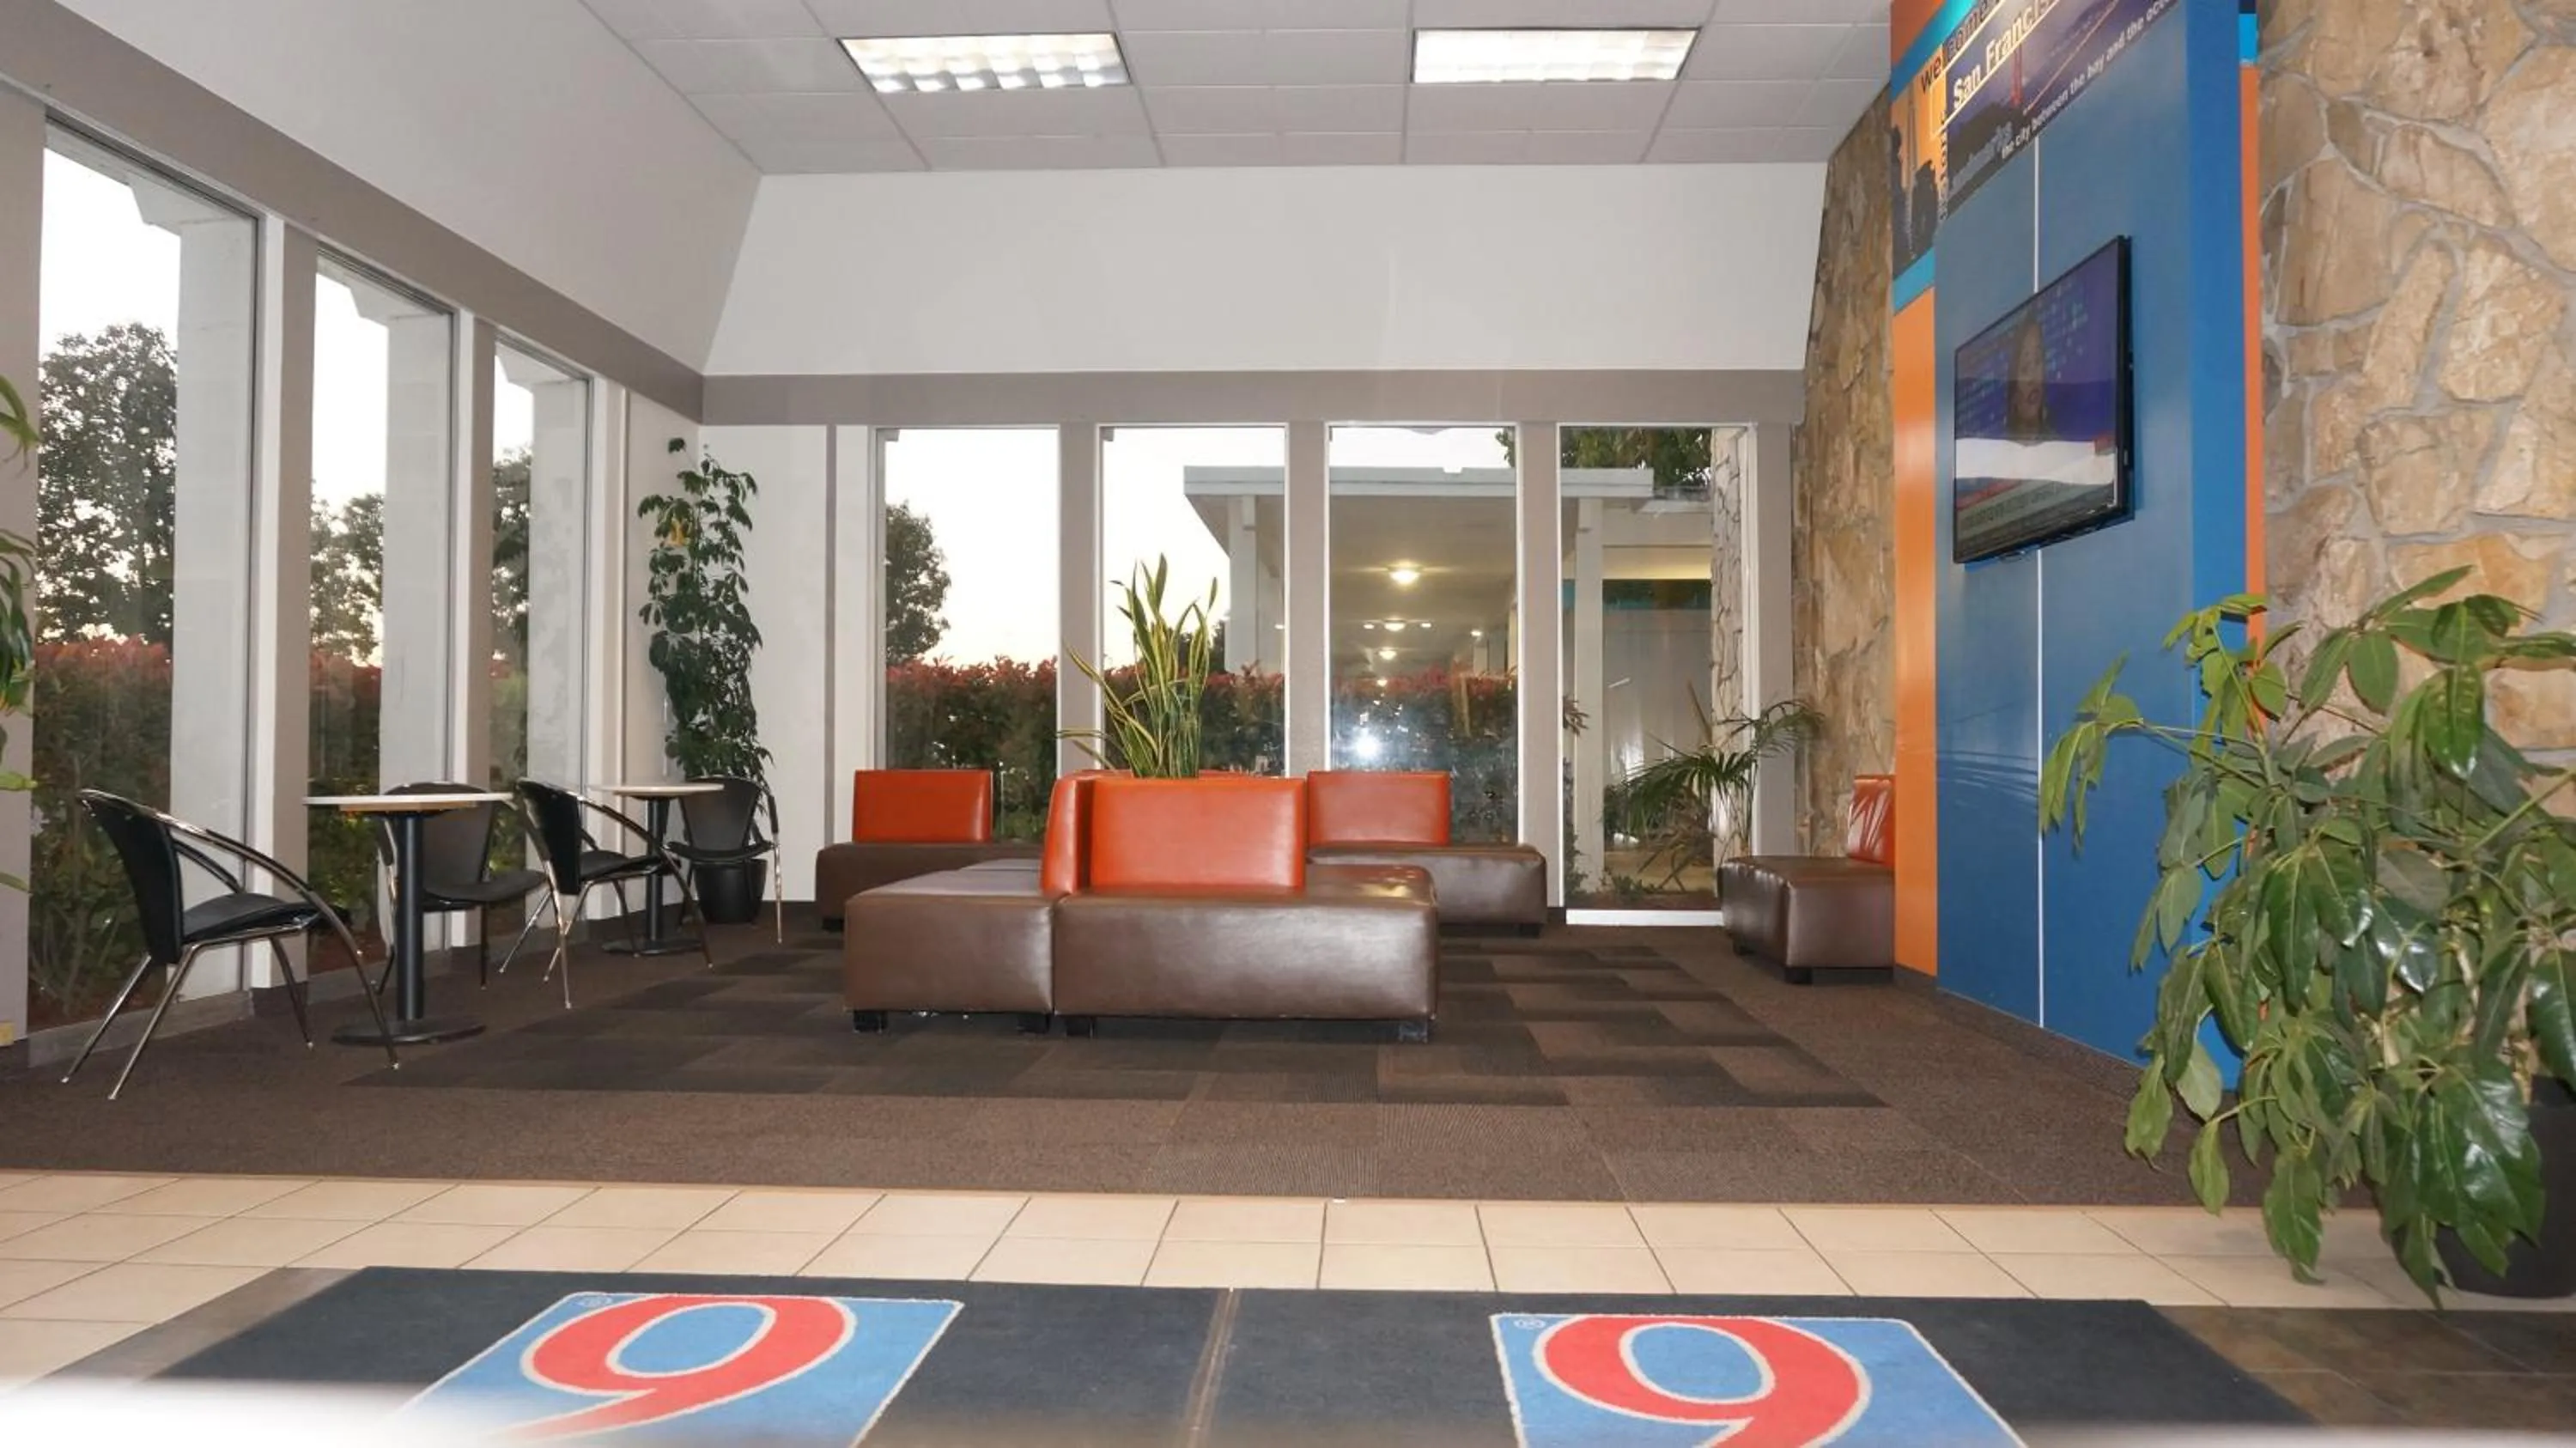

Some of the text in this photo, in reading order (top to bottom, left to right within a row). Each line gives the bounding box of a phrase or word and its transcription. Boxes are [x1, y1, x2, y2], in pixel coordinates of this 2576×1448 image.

[2070, 73, 2086, 94] the
[2106, 29, 2125, 62] and
[2126, 17, 2144, 40] the
[1953, 64, 1981, 109] San
